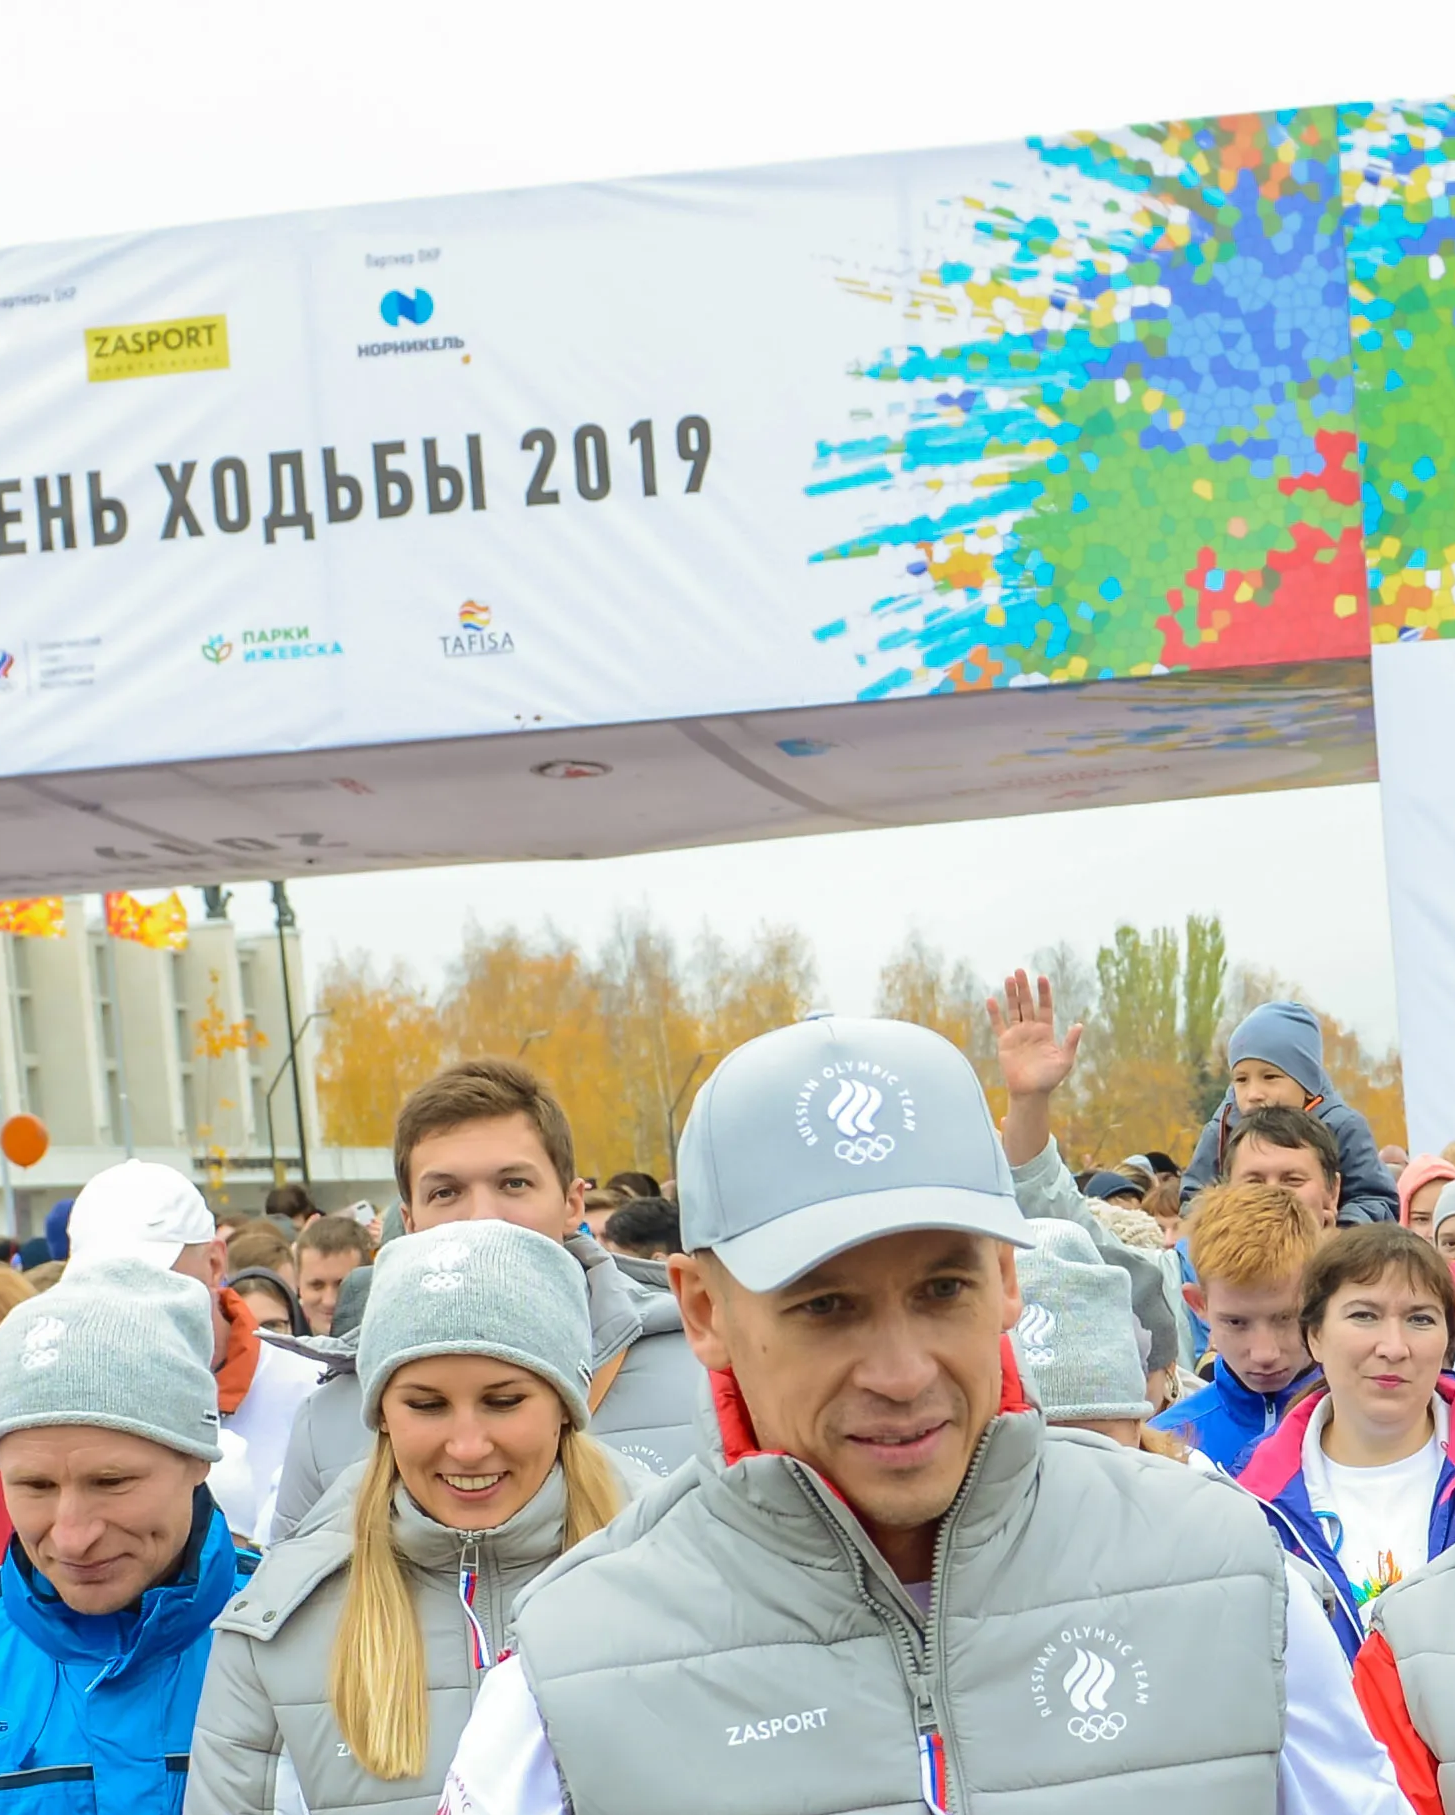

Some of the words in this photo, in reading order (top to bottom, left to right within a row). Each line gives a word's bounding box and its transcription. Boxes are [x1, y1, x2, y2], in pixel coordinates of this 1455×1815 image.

[94, 324, 217, 357] ZASPORT
[358, 336, 465, 357] НОРНИКЕЛЬ
[160, 433, 486, 543] ХОДЬБЫ
[521, 415, 713, 506] 2019
[242, 626, 309, 643] ПАРКИ
[440, 631, 514, 654] TAFISA
[244, 641, 343, 662] ИЖЕВСКА
[796, 1077, 819, 1146] RUSSIAN
[823, 1060, 899, 1086] OLYMPIC
[898, 1088, 916, 1132] TEAM
[621, 1444, 663, 1463] OLYMPIC
[1031, 1643, 1057, 1718] RUSSIAN
[1060, 1626, 1133, 1656] OLYMPIC
[1131, 1659, 1147, 1705] TEAM
[726, 1707, 827, 1746] ZASPORT
